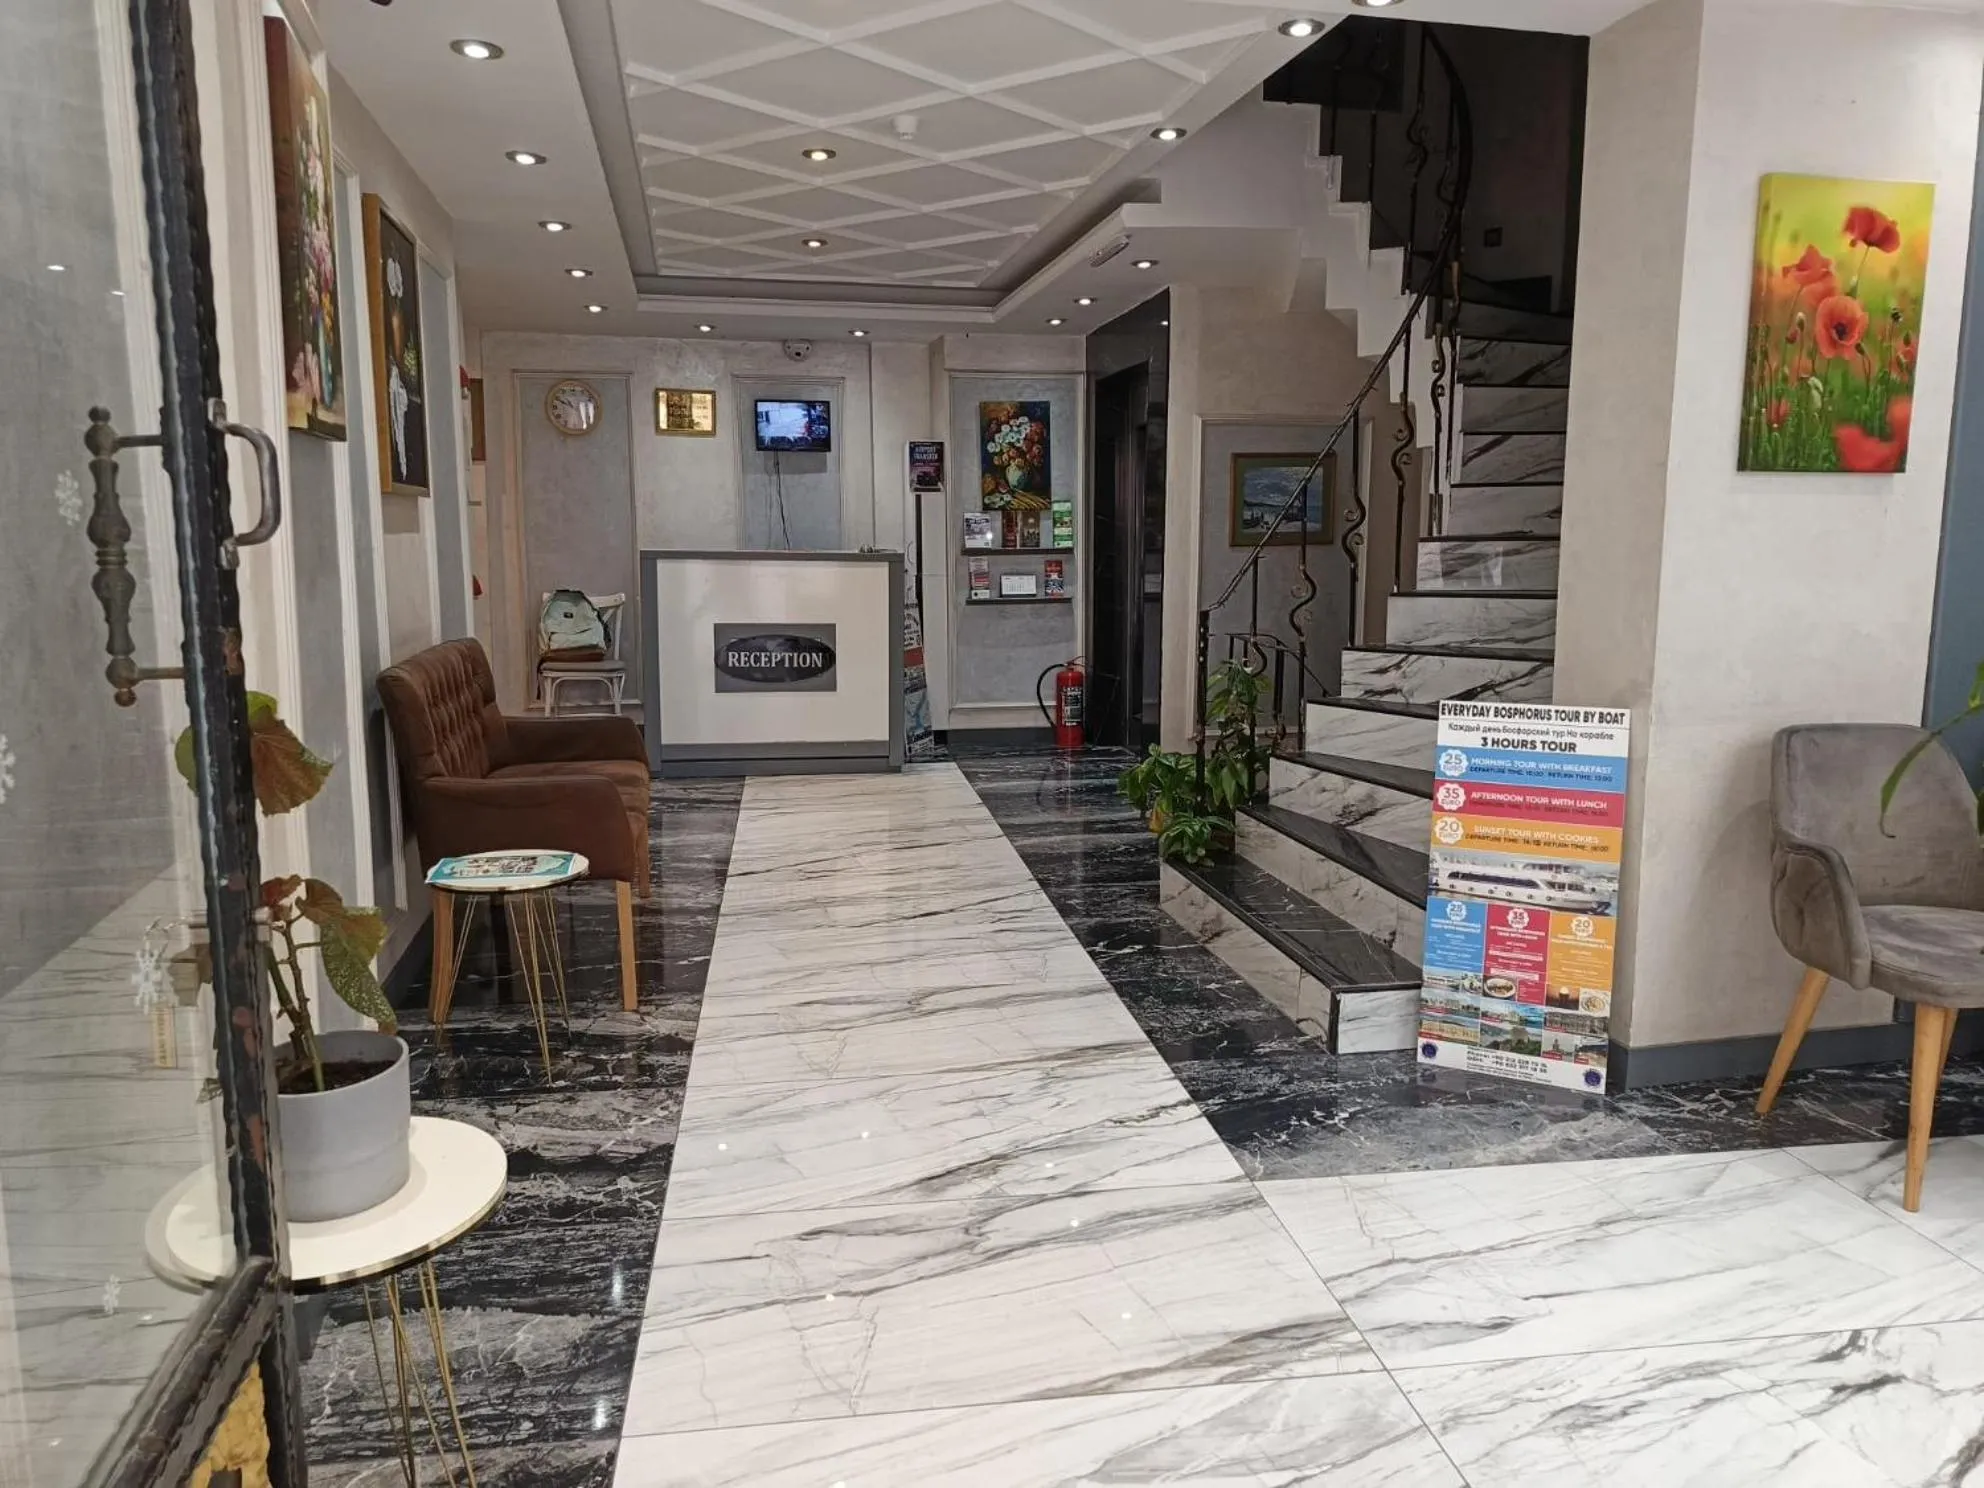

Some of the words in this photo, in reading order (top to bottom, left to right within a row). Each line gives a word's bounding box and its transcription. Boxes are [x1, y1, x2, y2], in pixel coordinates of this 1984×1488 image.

[728, 651, 823, 668] RECEPTION
[1441, 702, 1491, 718] EVERYDAY
[1493, 705, 1552, 721] BOSPHORUS
[1554, 708, 1581, 723] TOUR
[1583, 710, 1597, 723] BY
[1598, 711, 1626, 725] BOAT
[1448, 722, 1481, 733] Каждый
[1482, 725, 1502, 734] день
[1502, 724, 1550, 736] Босфорский
[1552, 729, 1566, 739] тур
[1579, 730, 1614, 741] корабле
[1481, 736, 1488, 748] 3
[1491, 737, 1538, 751] HOURS
[1540, 740, 1578, 753] TOUR
[1444, 753, 1463, 765] 25
[1470, 757, 1512, 768] MORNING
[1513, 760, 1537, 769] TOUR
[1538, 762, 1561, 771] WITH
[1562, 763, 1613, 774] BREAKFAST
[1443, 787, 1460, 799] 35
[1470, 791, 1524, 803] AFTERNOON
[1525, 795, 1549, 805] TOUR
[1550, 797, 1575, 807] WITH
[1576, 799, 1608, 810] LUNCH
[1439, 820, 1460, 833] 20
[1473, 824, 1506, 836] SUNSET
[1508, 828, 1532, 839] TOUR
[1533, 830, 1557, 841] WITH
[1512, 910, 1525, 920] 35
[1574, 920, 1591, 929] 20
